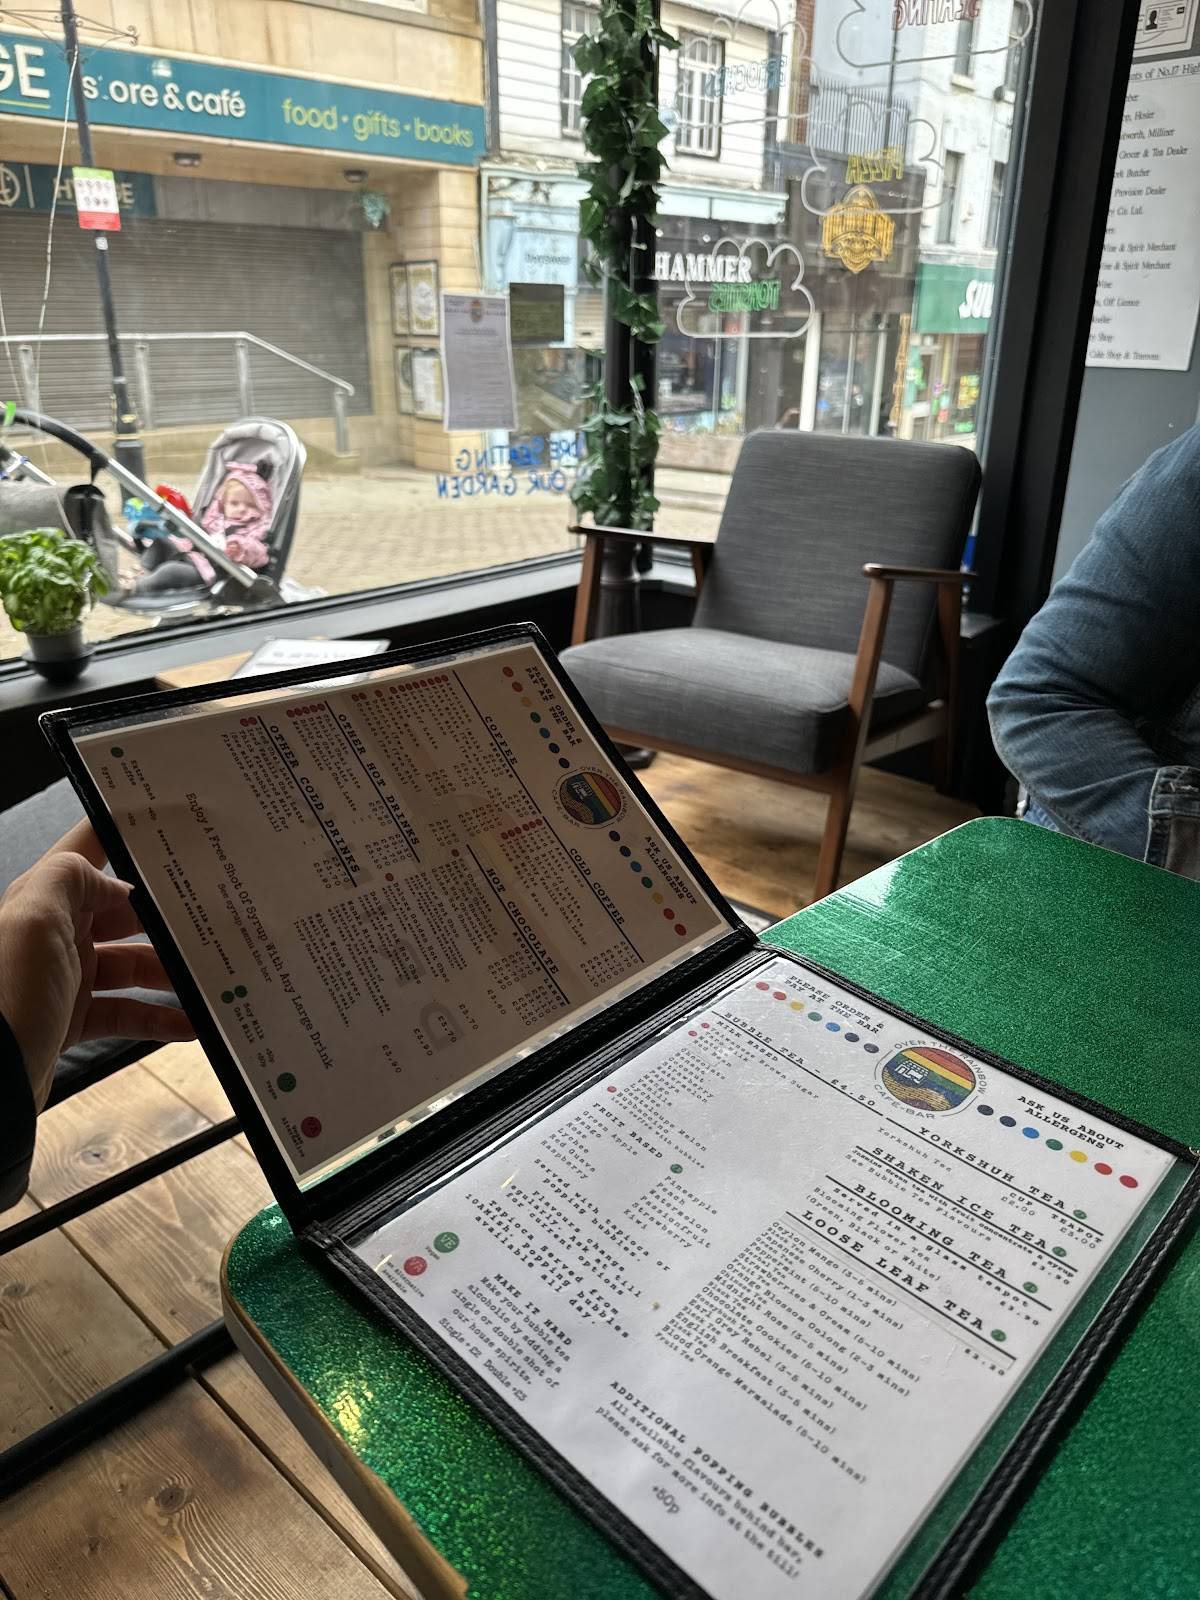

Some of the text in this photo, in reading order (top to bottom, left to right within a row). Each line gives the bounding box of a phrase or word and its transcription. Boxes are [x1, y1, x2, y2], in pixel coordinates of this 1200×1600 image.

[163, 83, 185, 111] &
[186, 89, 247, 118] café
[282, 98, 474, 148] food gifts books
[655, 251, 752, 283] HAMMER
[337, 713, 420, 845] OTHER HOT DRINKS
[484, 715, 518, 765] COFFEE
[269, 724, 360, 873] OTHER COLD DRINKS
[569, 847, 625, 925] COLD COFFEE
[644, 835, 697, 904] ASK US ABOUT
[644, 846, 684, 899] ALLERGENS
[185, 792, 333, 1069] Enjoy A Free Shot Of Syrup With Any Large Drink
[485, 867, 559, 974] HOT CHOCOLATE
[784, 978, 879, 1034] PAY AT THE BAR
[788, 975, 830, 999] PLEASE
[834, 1000, 870, 1022] ORDER
[715, 1020, 778, 1061] MILK BASED
[723, 1011, 772, 1043] BUBBLE
[778, 1046, 804, 1064] TEA
[830, 1078, 875, 1106] £4.50
[592, 1102, 663, 1158] FRUIT BASED
[1016, 1095, 1124, 1149] ASK US ABOUT
[1024, 1107, 1105, 1149] ALLERGENS
[871, 1146, 1046, 1249] SHAKEN ICE TEA
[918, 1126, 1064, 1209] YORKSHUH TEA
[531, 1189, 625, 1272] Flavours change
[533, 1158, 670, 1271] Served with tapioca or
[541, 1177, 640, 1261] popping bubbles.
[853, 1183, 1006, 1279] BLOOMING TEA
[488, 1199, 618, 1315] Tapioca Served from
[801, 1209, 982, 1330] LOOSE LEAF TEA
[450, 1288, 560, 1388] single or double shot of
[452, 1308, 531, 1385] our house spirits.
[466, 1283, 510, 1323] alcoholic
[509, 1321, 523, 1334] by
[521, 1334, 554, 1367] adding
[479, 1275, 570, 1361] Make your bubble tea
[493, 1273, 572, 1345] MAKE IT HARD
[609, 1380, 823, 1557] ADDITIONAL POPPING BUBBLES
[651, 1485, 680, 1514] +50p
